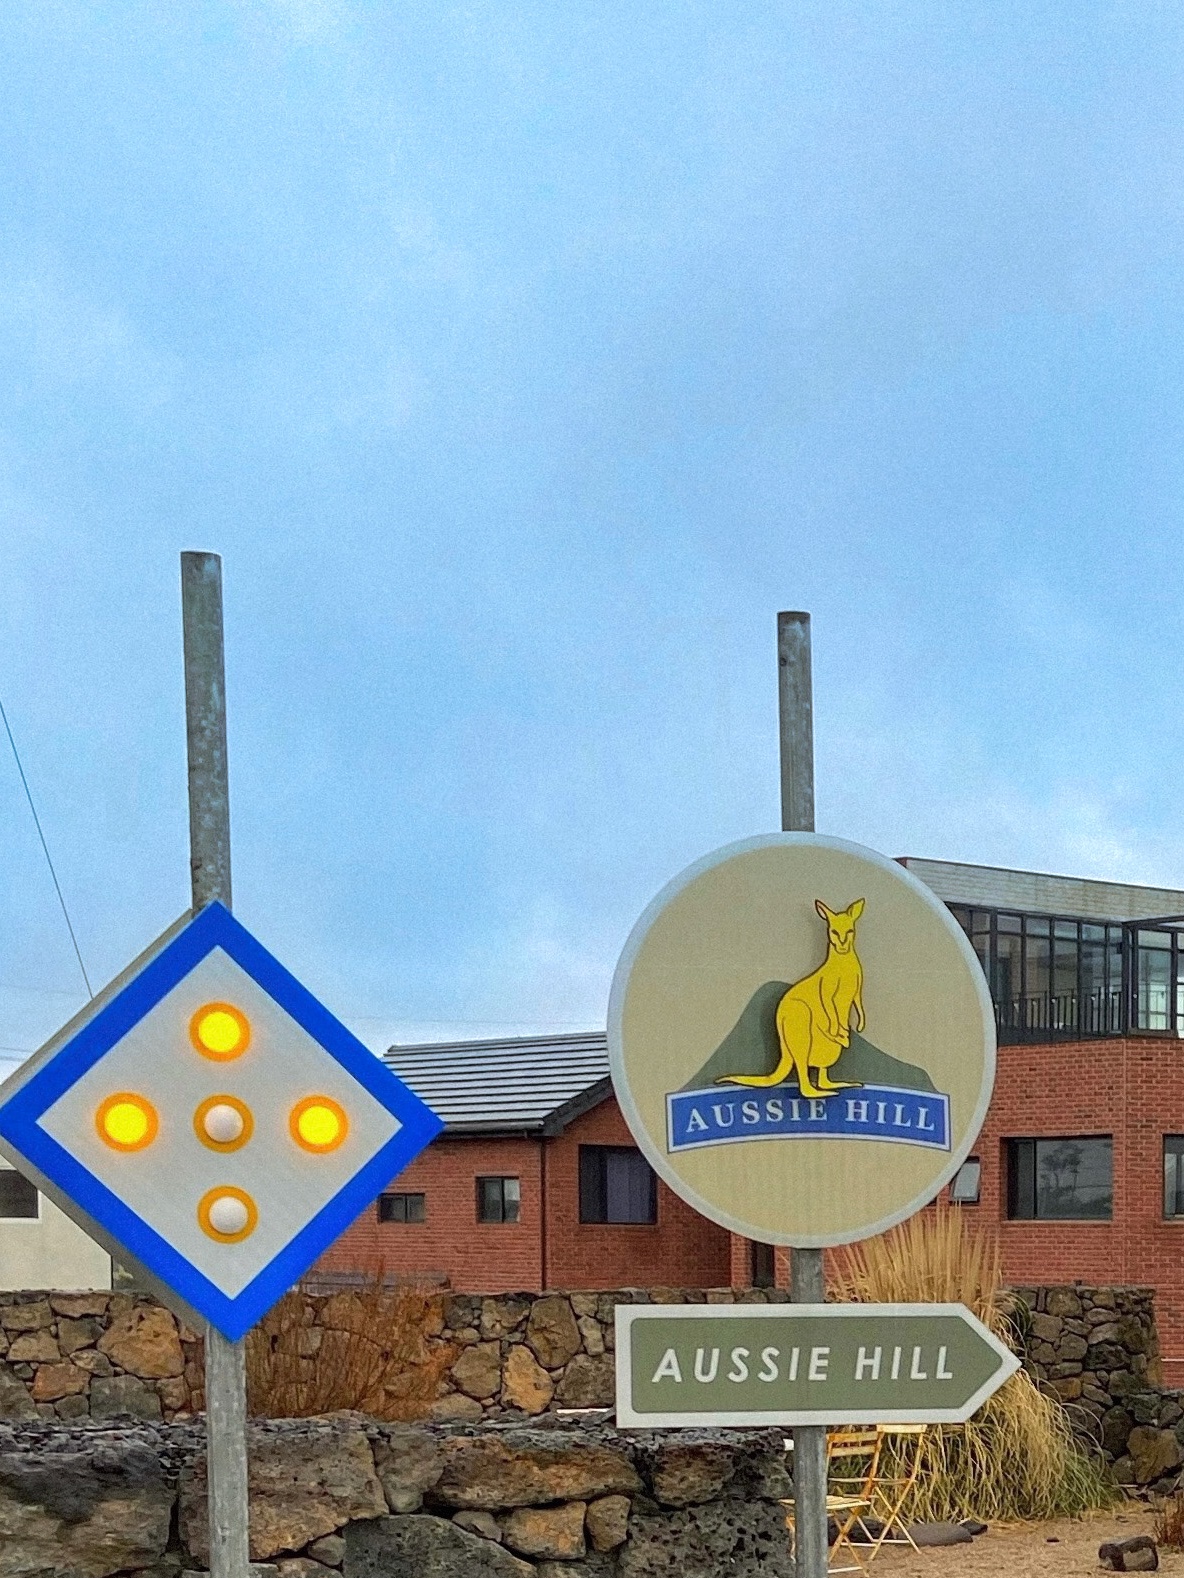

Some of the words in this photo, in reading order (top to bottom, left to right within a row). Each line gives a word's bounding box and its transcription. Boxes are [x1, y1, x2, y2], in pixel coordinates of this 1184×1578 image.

[685, 1098, 828, 1133] AUSSIE
[845, 1099, 936, 1131] HILL
[651, 1346, 831, 1383] AUSSIE
[854, 1346, 953, 1381] HILL
